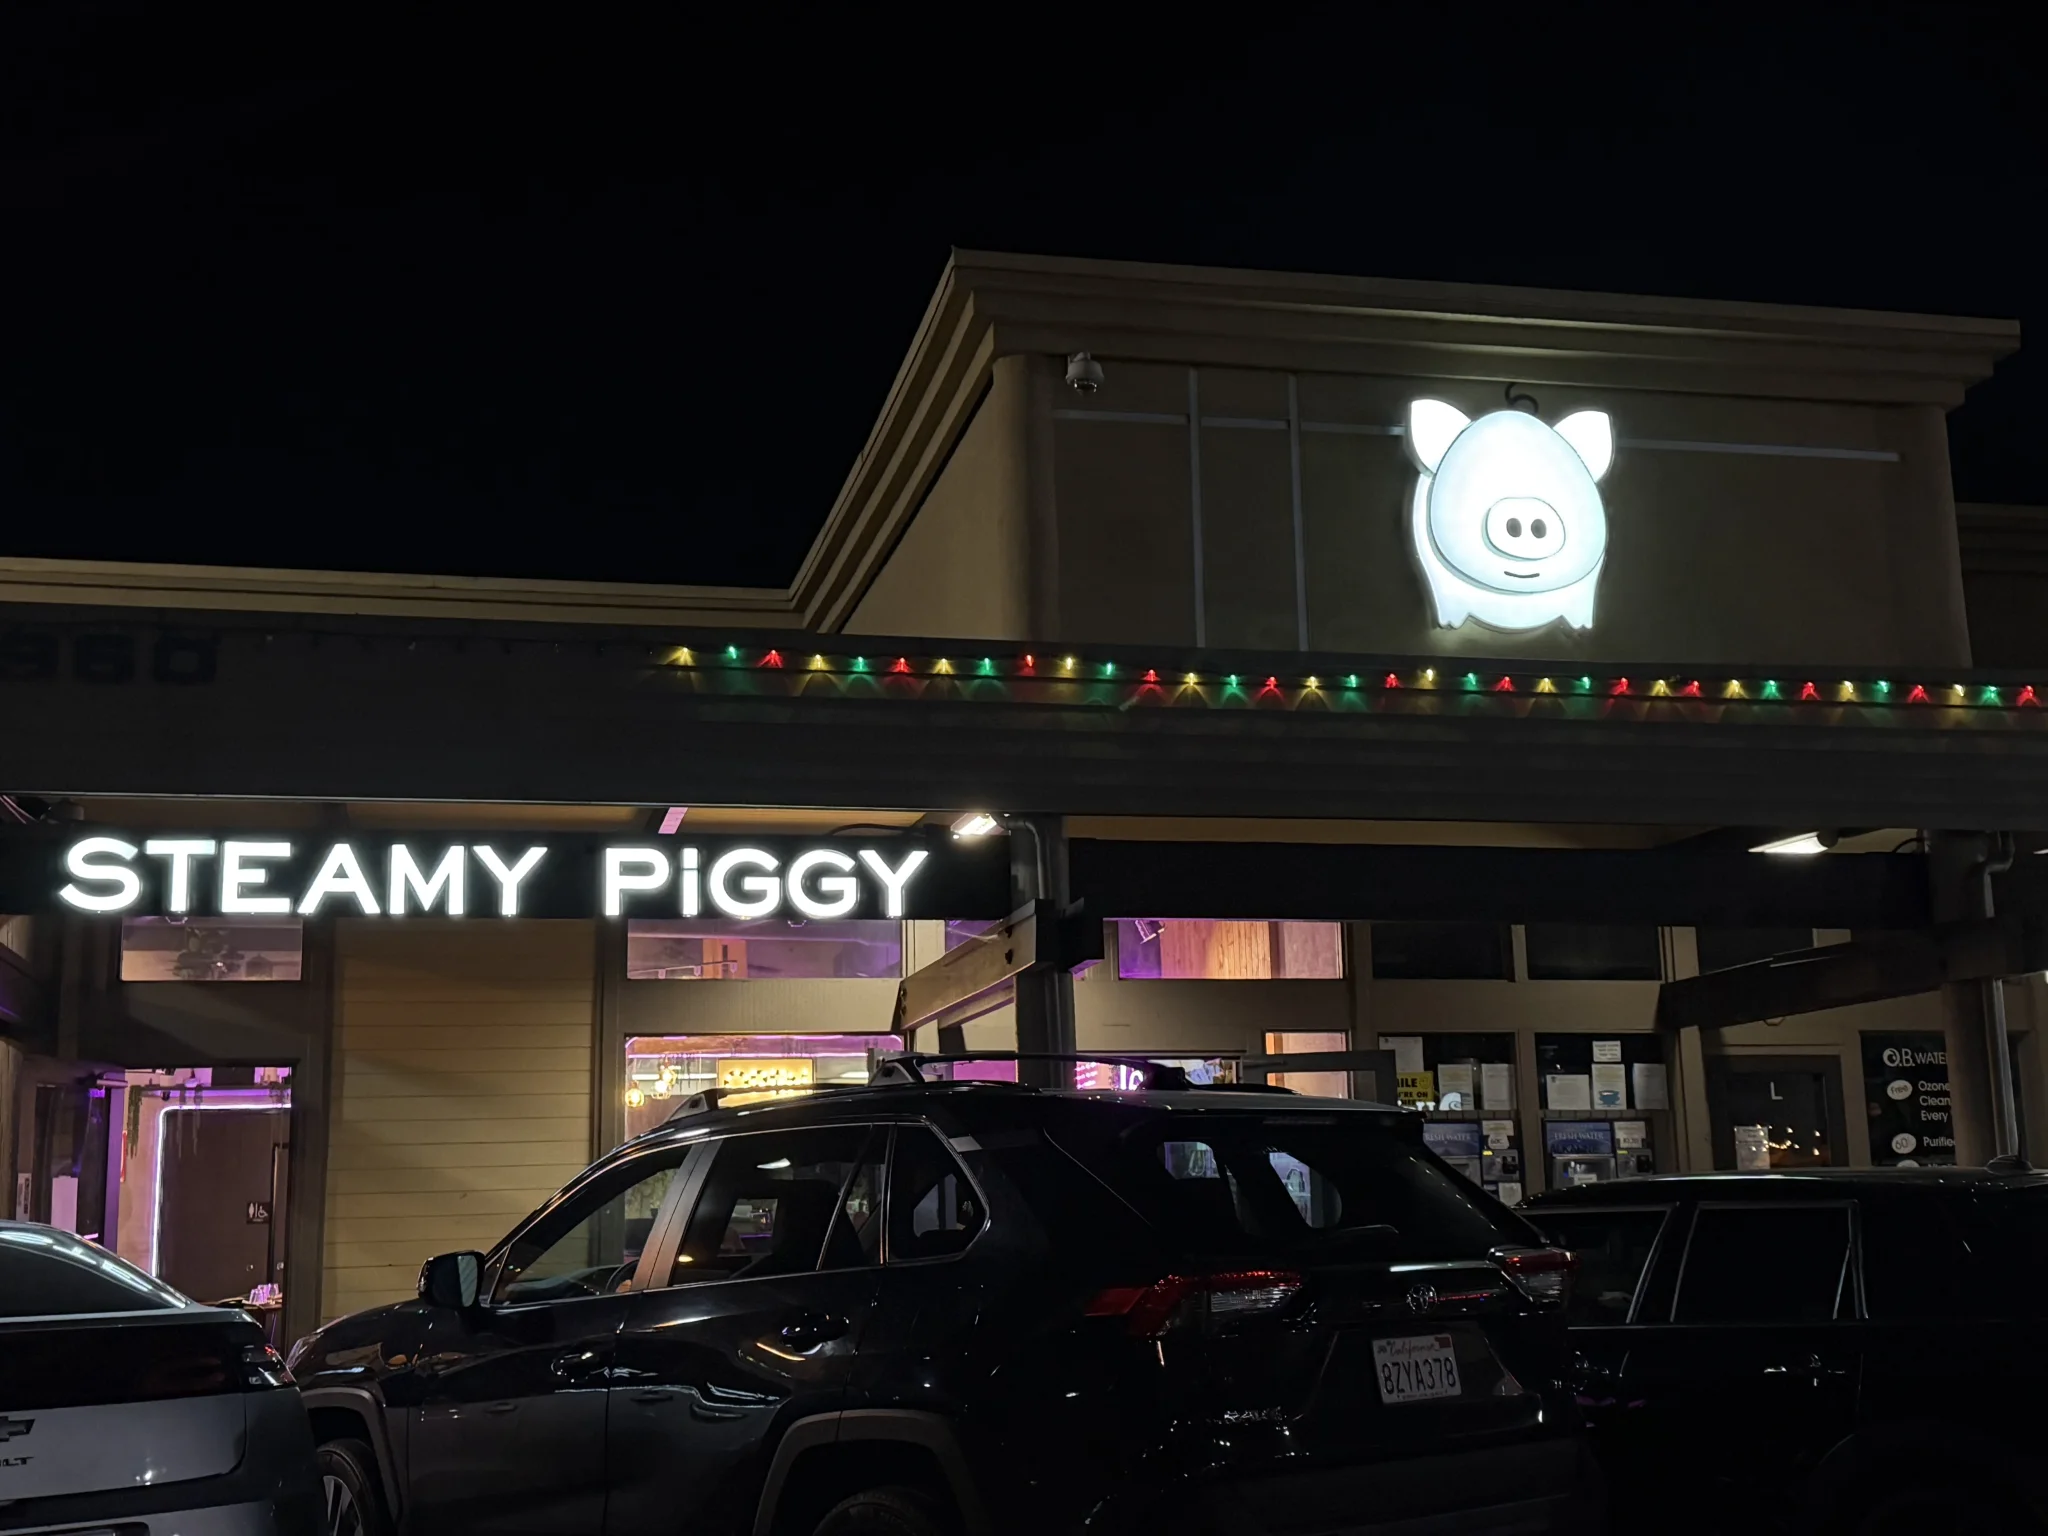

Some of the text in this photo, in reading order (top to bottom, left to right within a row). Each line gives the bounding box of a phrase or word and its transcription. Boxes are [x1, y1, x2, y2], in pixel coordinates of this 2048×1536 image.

[59, 836, 548, 916] STEAMY
[1914, 1051, 1947, 1065] WATE
[1770, 1081, 1784, 1100] L
[1920, 1110, 1949, 1123] Every
[1382, 1357, 1456, 1395] 8ZYA378
